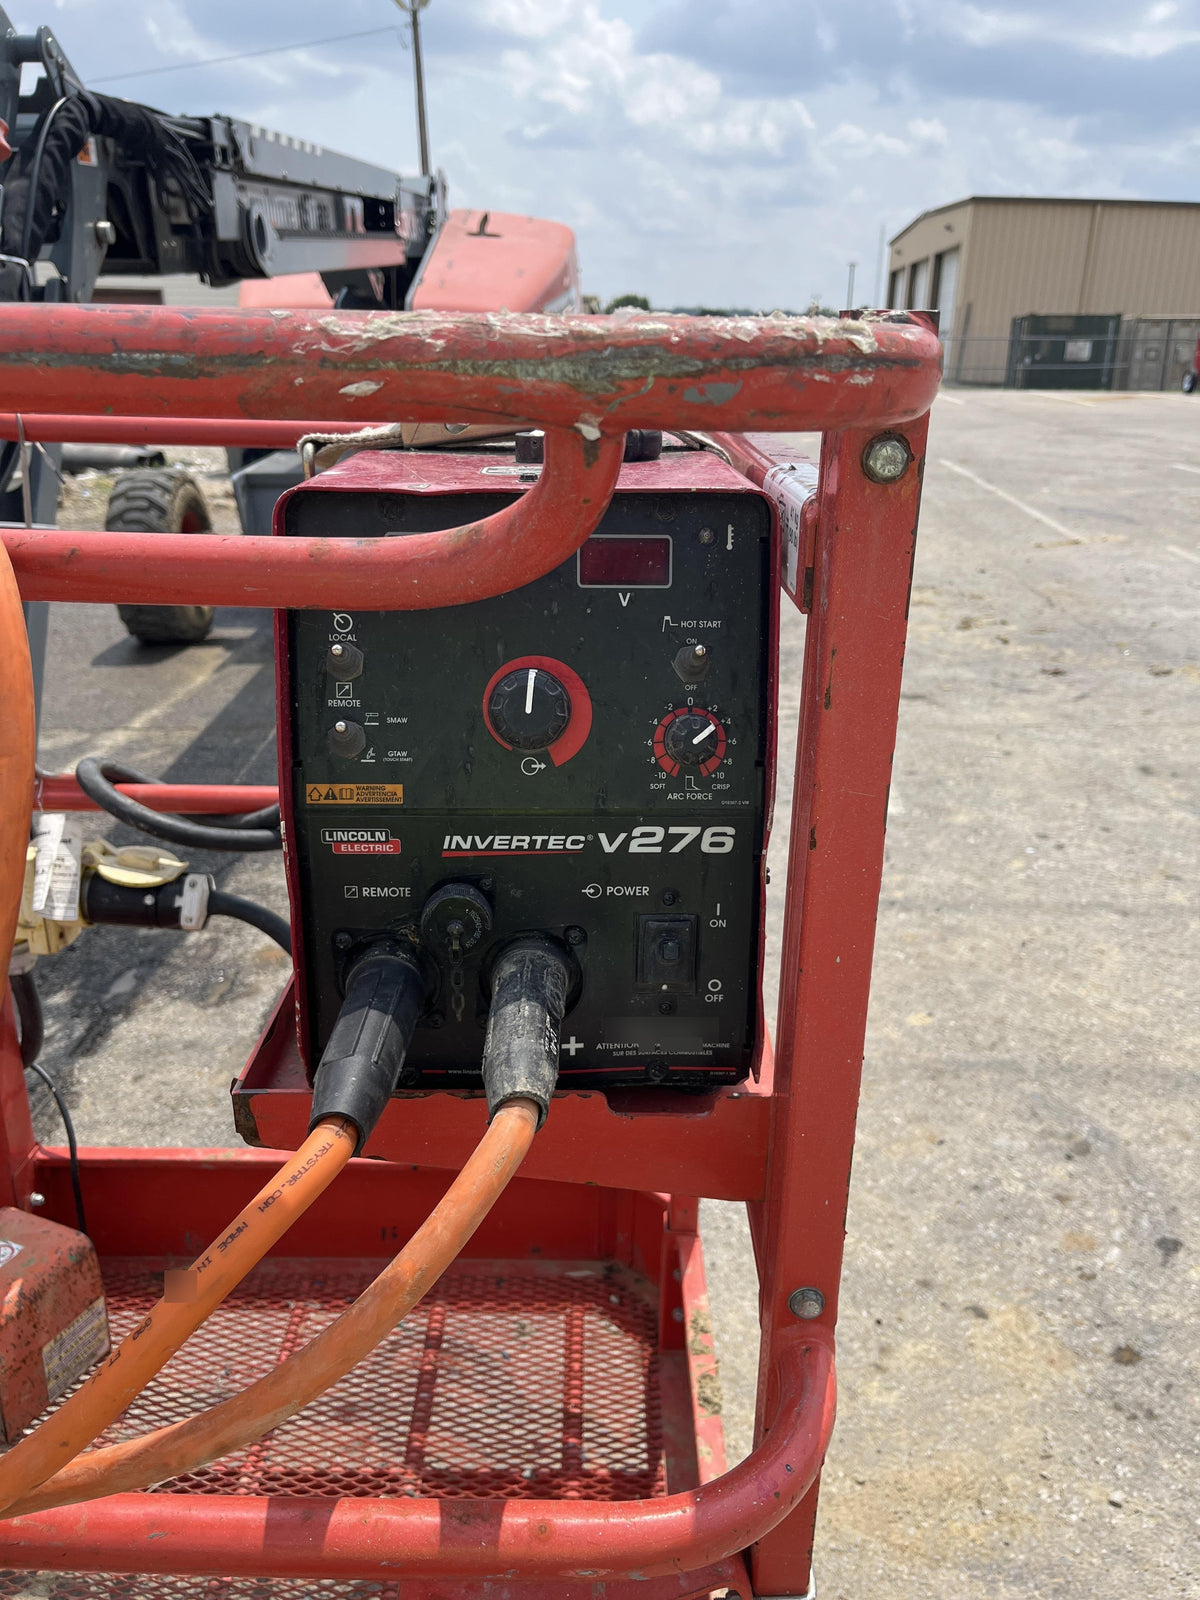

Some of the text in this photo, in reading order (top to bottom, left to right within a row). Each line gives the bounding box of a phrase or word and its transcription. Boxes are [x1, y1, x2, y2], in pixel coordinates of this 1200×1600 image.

[618, 592, 631, 607] V
[680, 620, 722, 628] HOT START
[328, 633, 357, 642] LOCAL
[328, 699, 361, 708] REMOTE
[687, 697, 694, 706] 0
[666, 793, 713, 801] ARC FORCE
[325, 831, 386, 842] LINCOLN
[341, 844, 394, 852] ELECTRIC
[362, 887, 411, 897] REMOTE
[606, 886, 650, 897] POWER
[709, 919, 727, 928] ON
[705, 994, 724, 1003] OFF
[257, 1141, 335, 1214] TRYSTAR.COM
[216, 1220, 249, 1253] MADE
[196, 1255, 213, 1273] IN
